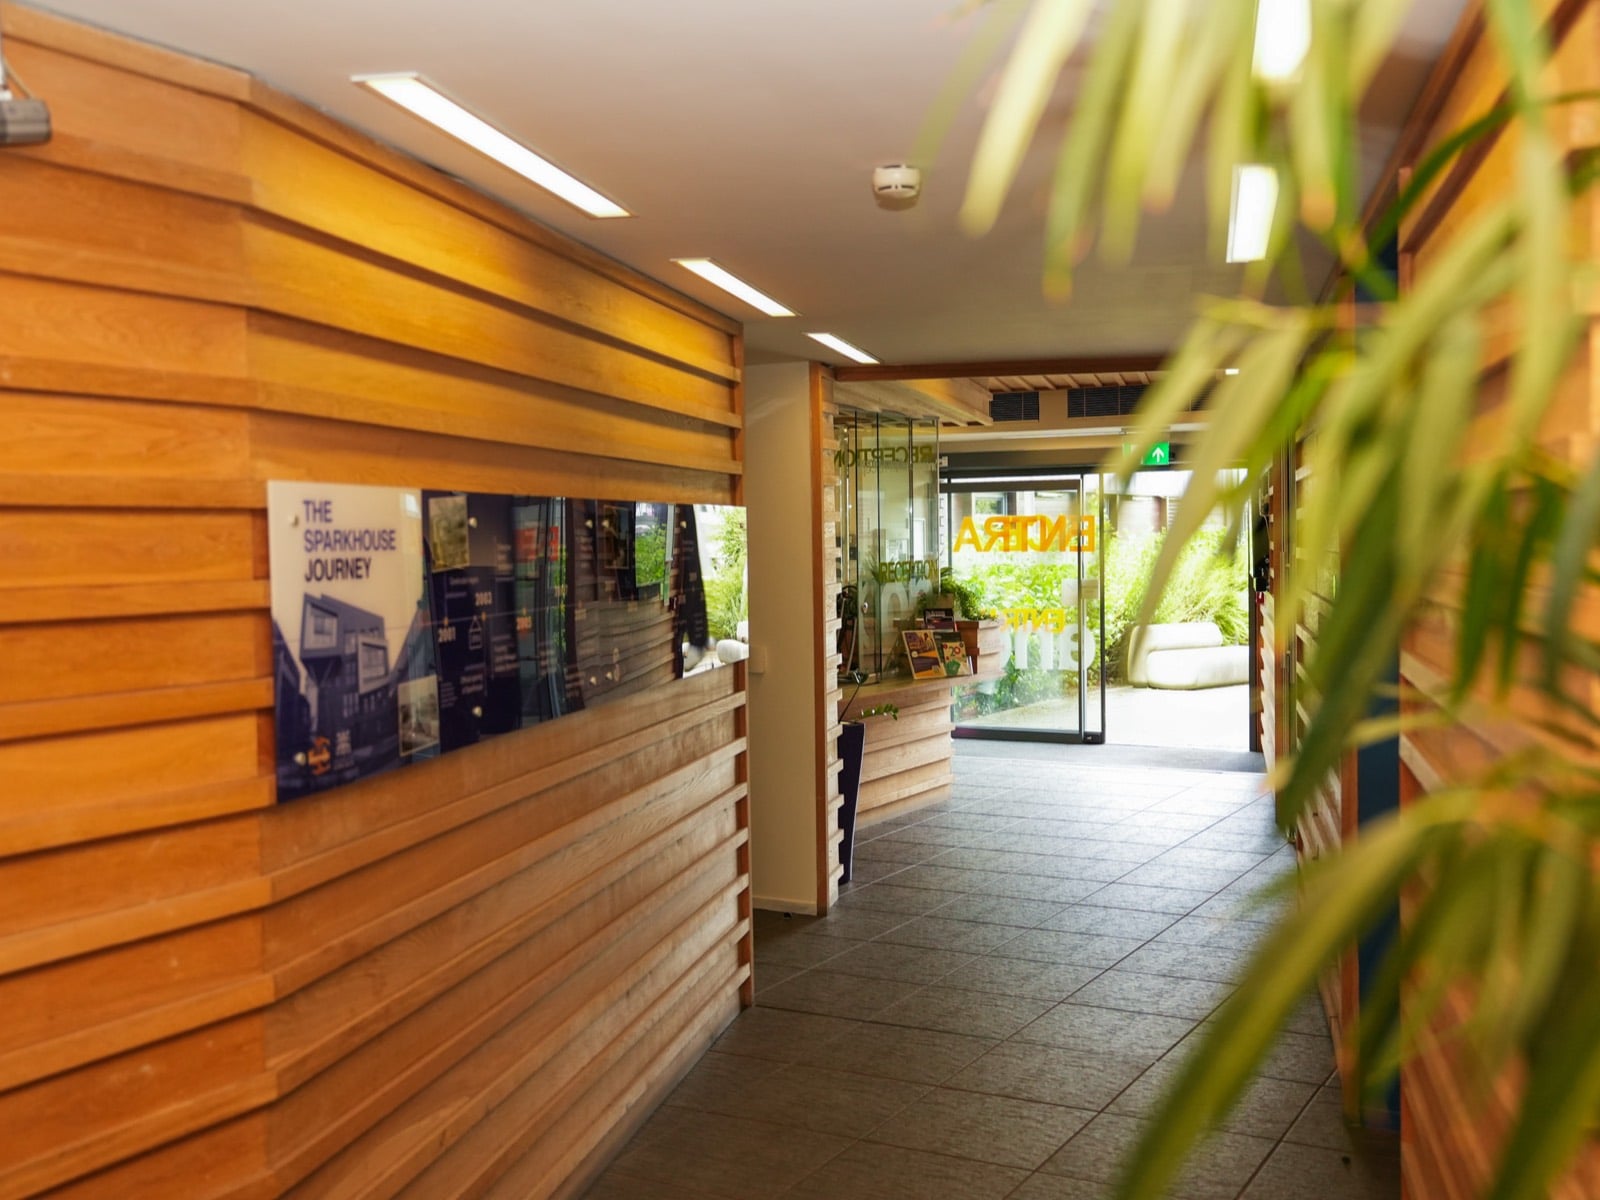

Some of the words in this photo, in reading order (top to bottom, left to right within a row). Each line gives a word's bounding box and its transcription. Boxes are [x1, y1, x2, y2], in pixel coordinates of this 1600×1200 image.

[303, 500, 332, 523] THE
[304, 530, 396, 553] SPARKHOUSE
[304, 557, 371, 582] JOURNEY
